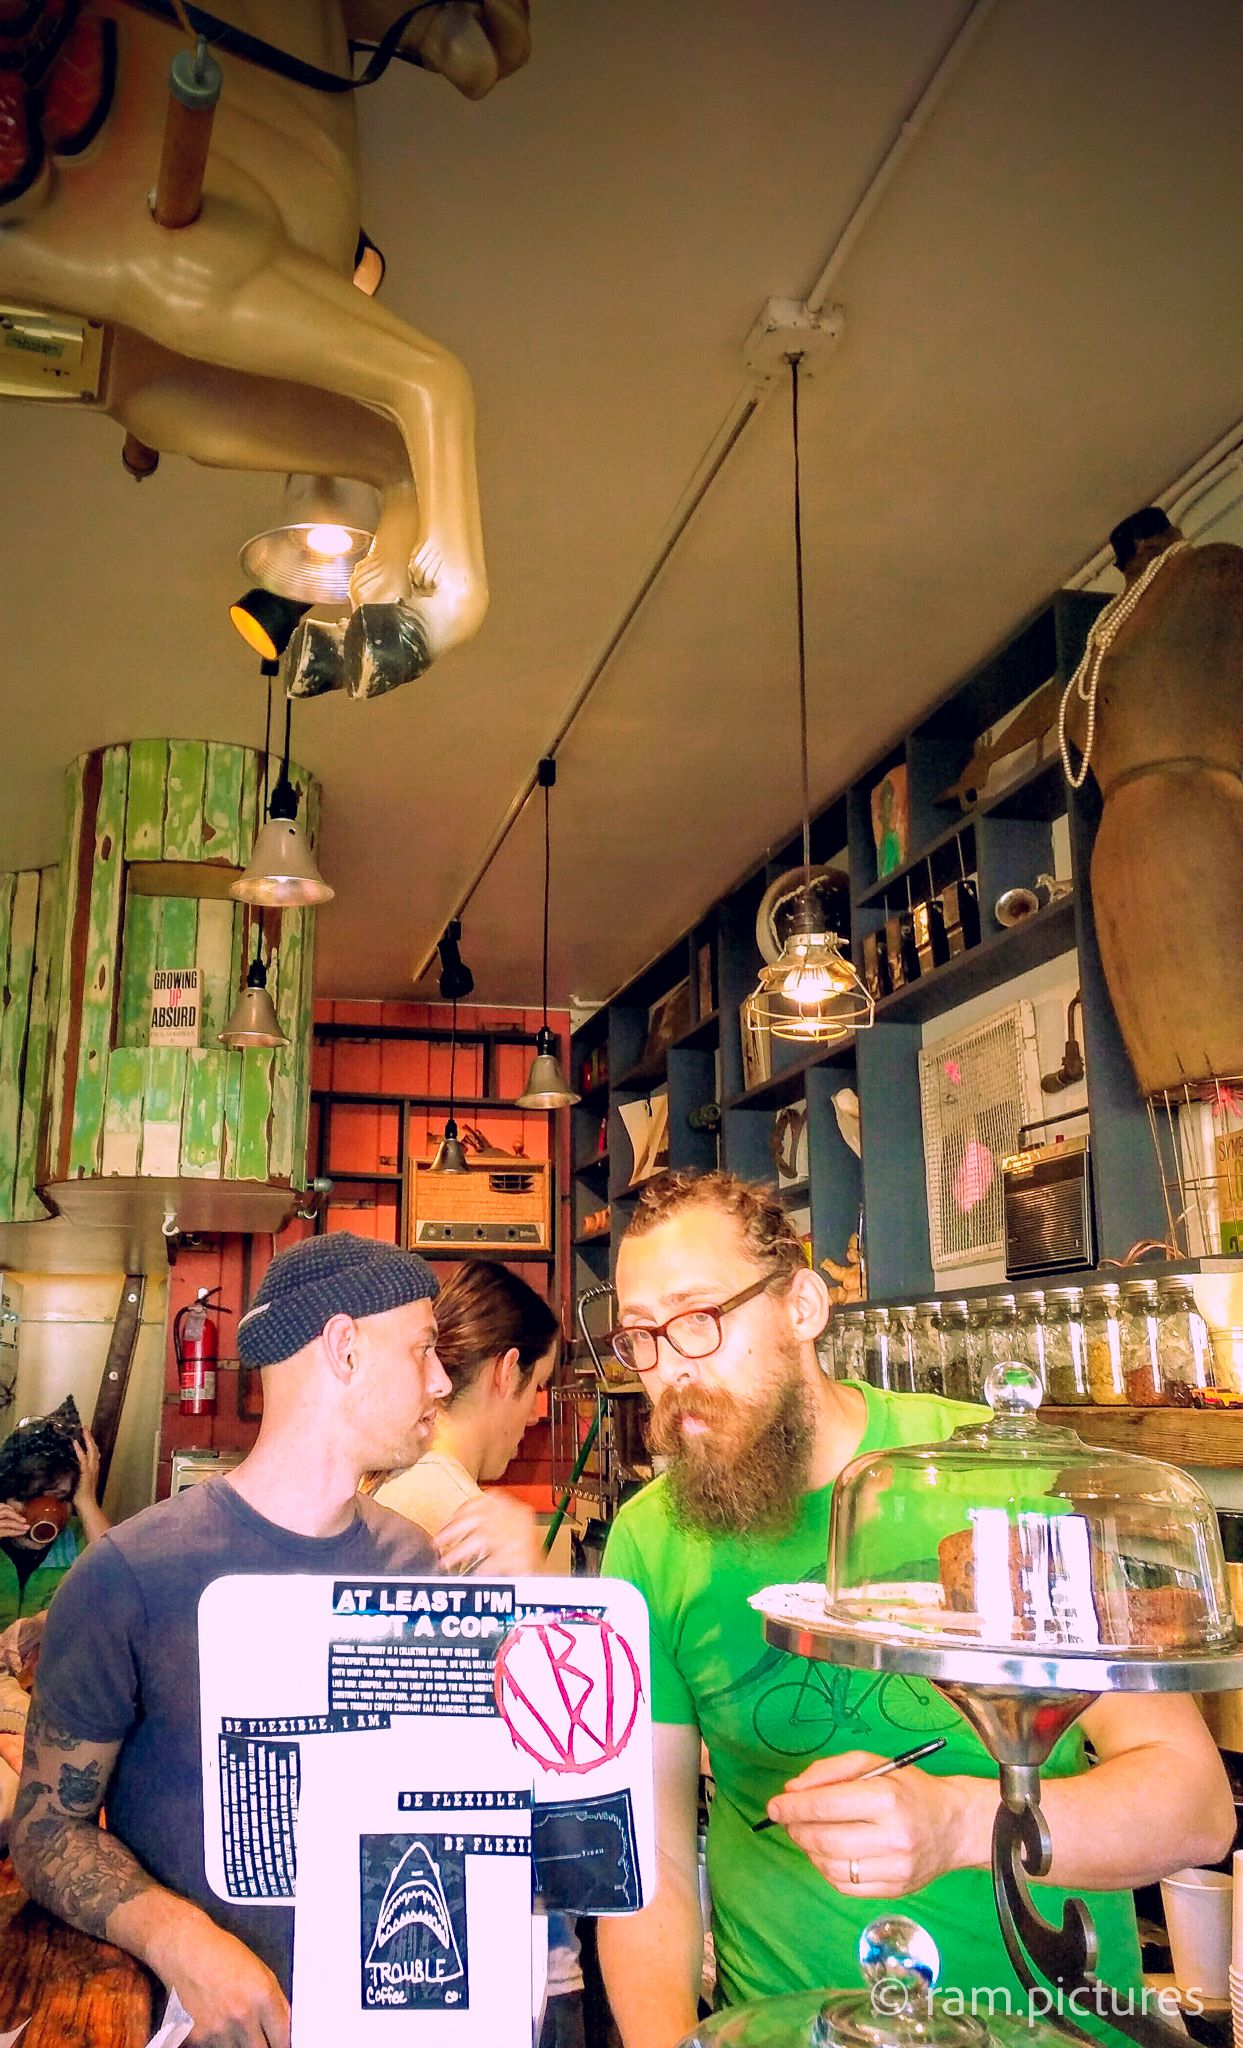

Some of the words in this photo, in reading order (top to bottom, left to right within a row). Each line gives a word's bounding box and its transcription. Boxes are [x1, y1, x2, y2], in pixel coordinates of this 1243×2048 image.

[154, 971, 197, 989] GROWING
[169, 988, 182, 1007] UP
[151, 1006, 197, 1028] ABSURD
[336, 1589, 373, 1613] AT
[379, 1590, 467, 1612] LEAST
[474, 1591, 513, 1613] I'M
[413, 1615, 436, 1637] A
[441, 1615, 499, 1639] COP
[225, 1720, 242, 1733] BE
[249, 1717, 334, 1733] FLEXIBLE,
[342, 1716, 349, 1728] I
[357, 1714, 387, 1728] AM.
[403, 1793, 423, 1807] BE
[432, 1793, 523, 1808] FLEXIBLE,
[444, 1836, 464, 1851] BE
[371, 1958, 447, 1987] TROUBLE
